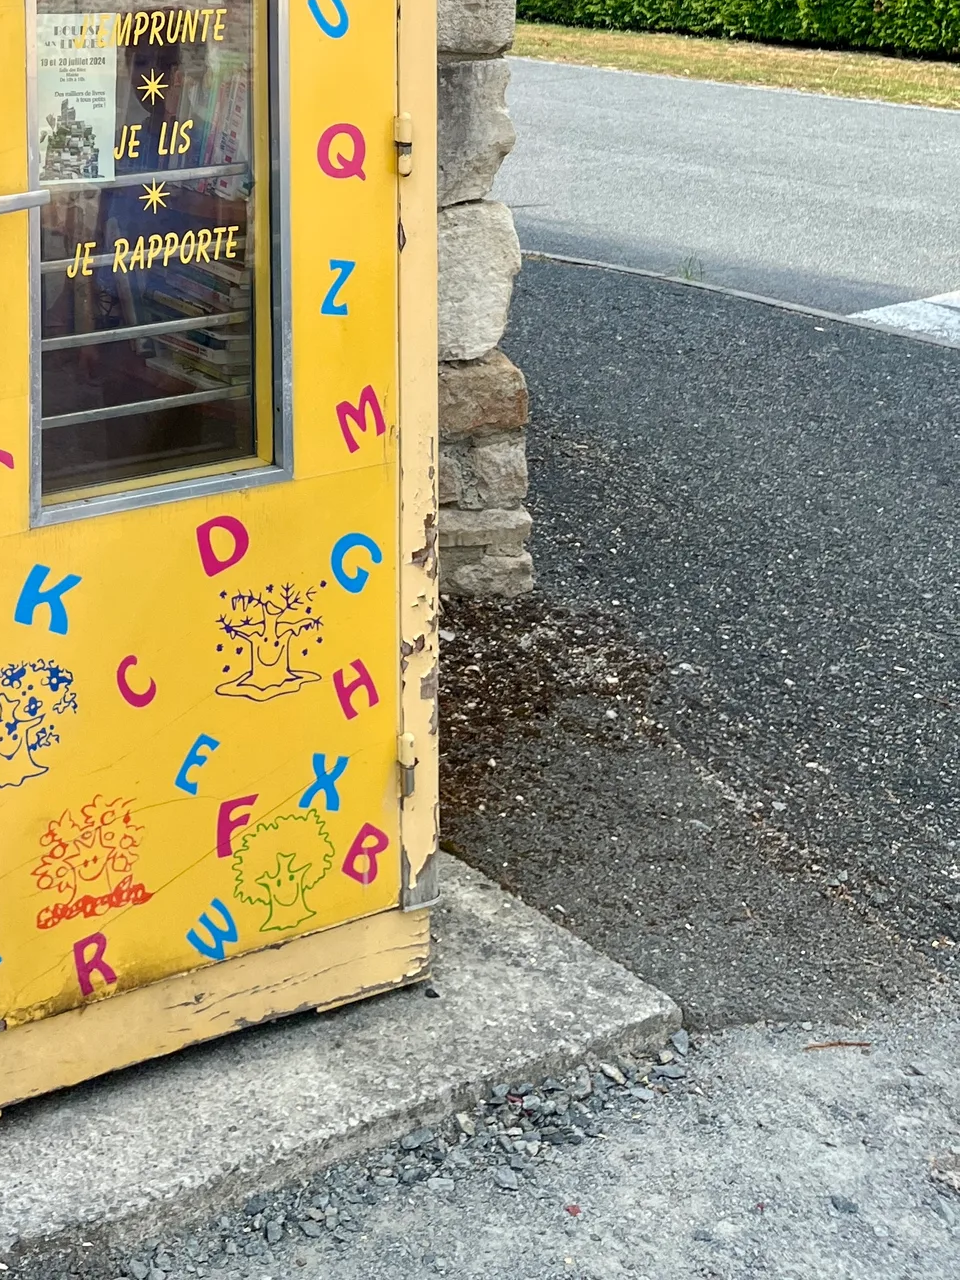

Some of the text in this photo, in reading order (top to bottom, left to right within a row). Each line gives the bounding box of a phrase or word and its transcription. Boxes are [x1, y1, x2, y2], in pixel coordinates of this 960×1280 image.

[73, 9, 227, 49] J'EMPRUNTE
[59, 58, 67, 66] 20
[89, 57, 106, 65] 2024
[113, 125, 142, 160] JE
[158, 119, 193, 156] LIS
[317, 123, 366, 181] Q
[66, 225, 239, 278] JE RAPPORTE
[336, 384, 386, 453] M
[196, 515, 249, 577] D
[13, 563, 82, 635] K
[116, 654, 157, 708] C
[332, 658, 379, 720] H
[174, 733, 220, 795] E
[298, 752, 349, 812] X
[217, 793, 259, 858] F
[341, 822, 389, 885] B
[186, 897, 240, 960] W
[72, 931, 117, 997] R
